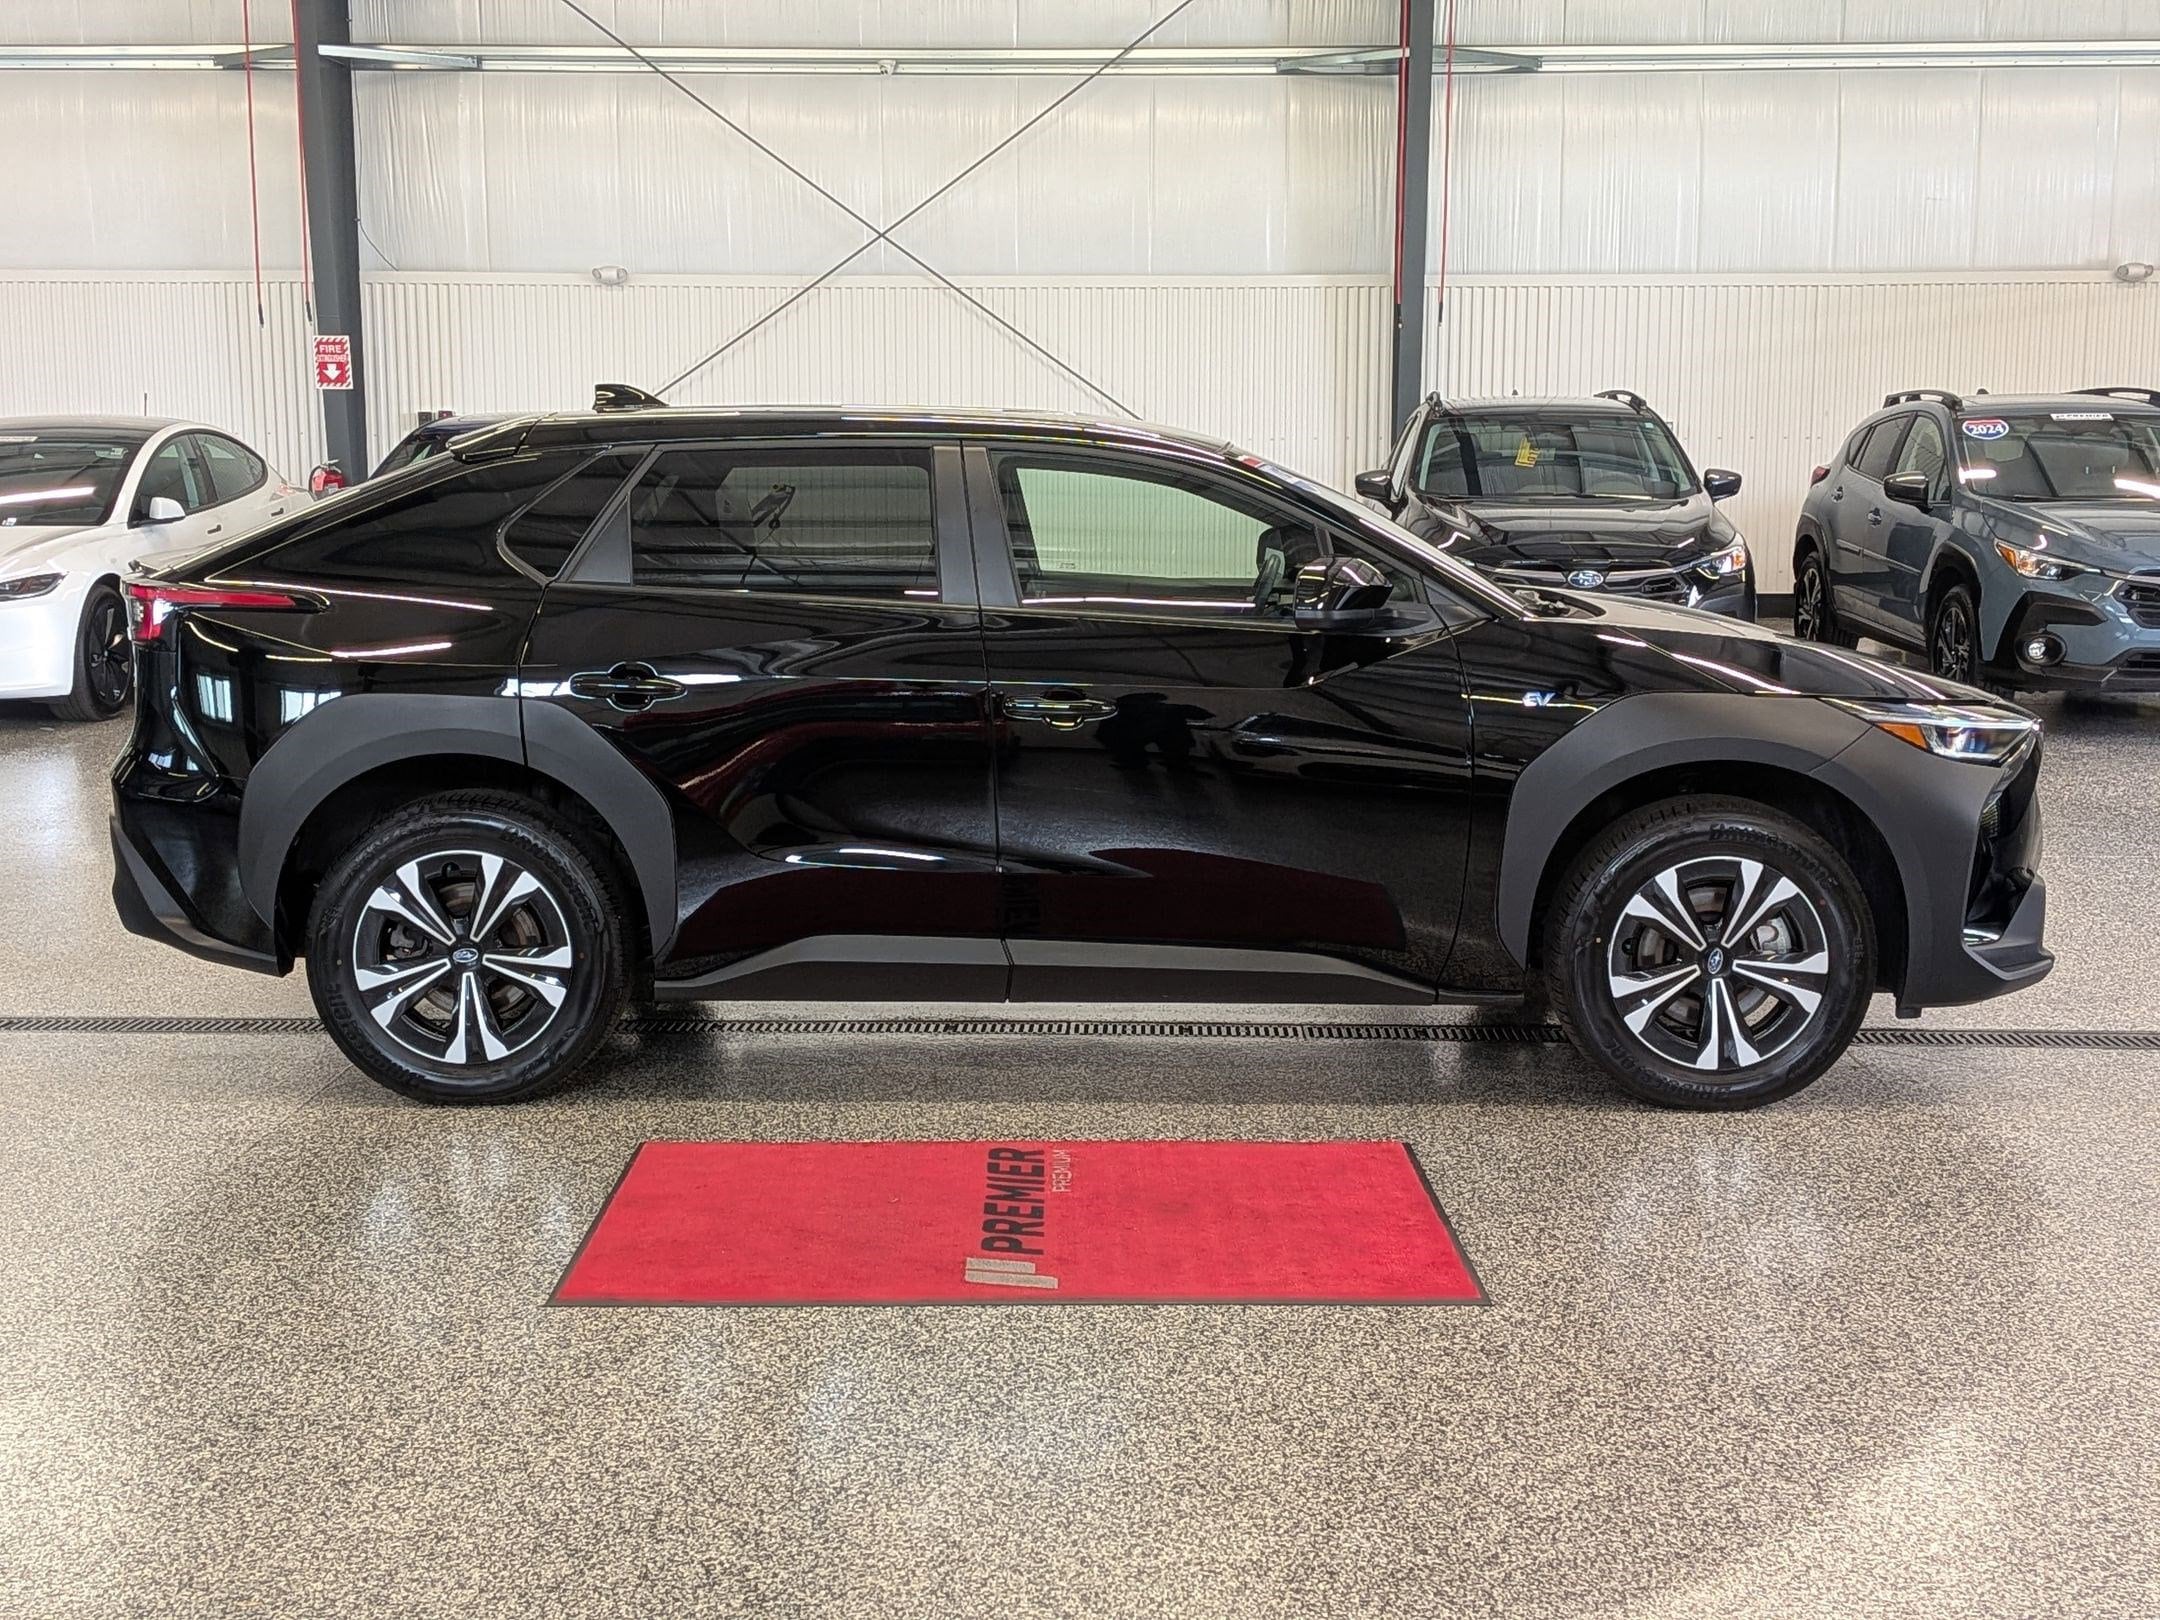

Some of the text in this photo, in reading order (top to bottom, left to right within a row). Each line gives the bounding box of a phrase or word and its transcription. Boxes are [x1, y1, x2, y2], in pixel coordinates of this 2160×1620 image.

[319, 344, 342, 354] FIRE
[1968, 424, 2005, 434] 2024
[1522, 691, 1556, 707] EV
[1051, 1149, 1073, 1193] PREMIUM
[980, 1147, 1046, 1256] PREMIER
